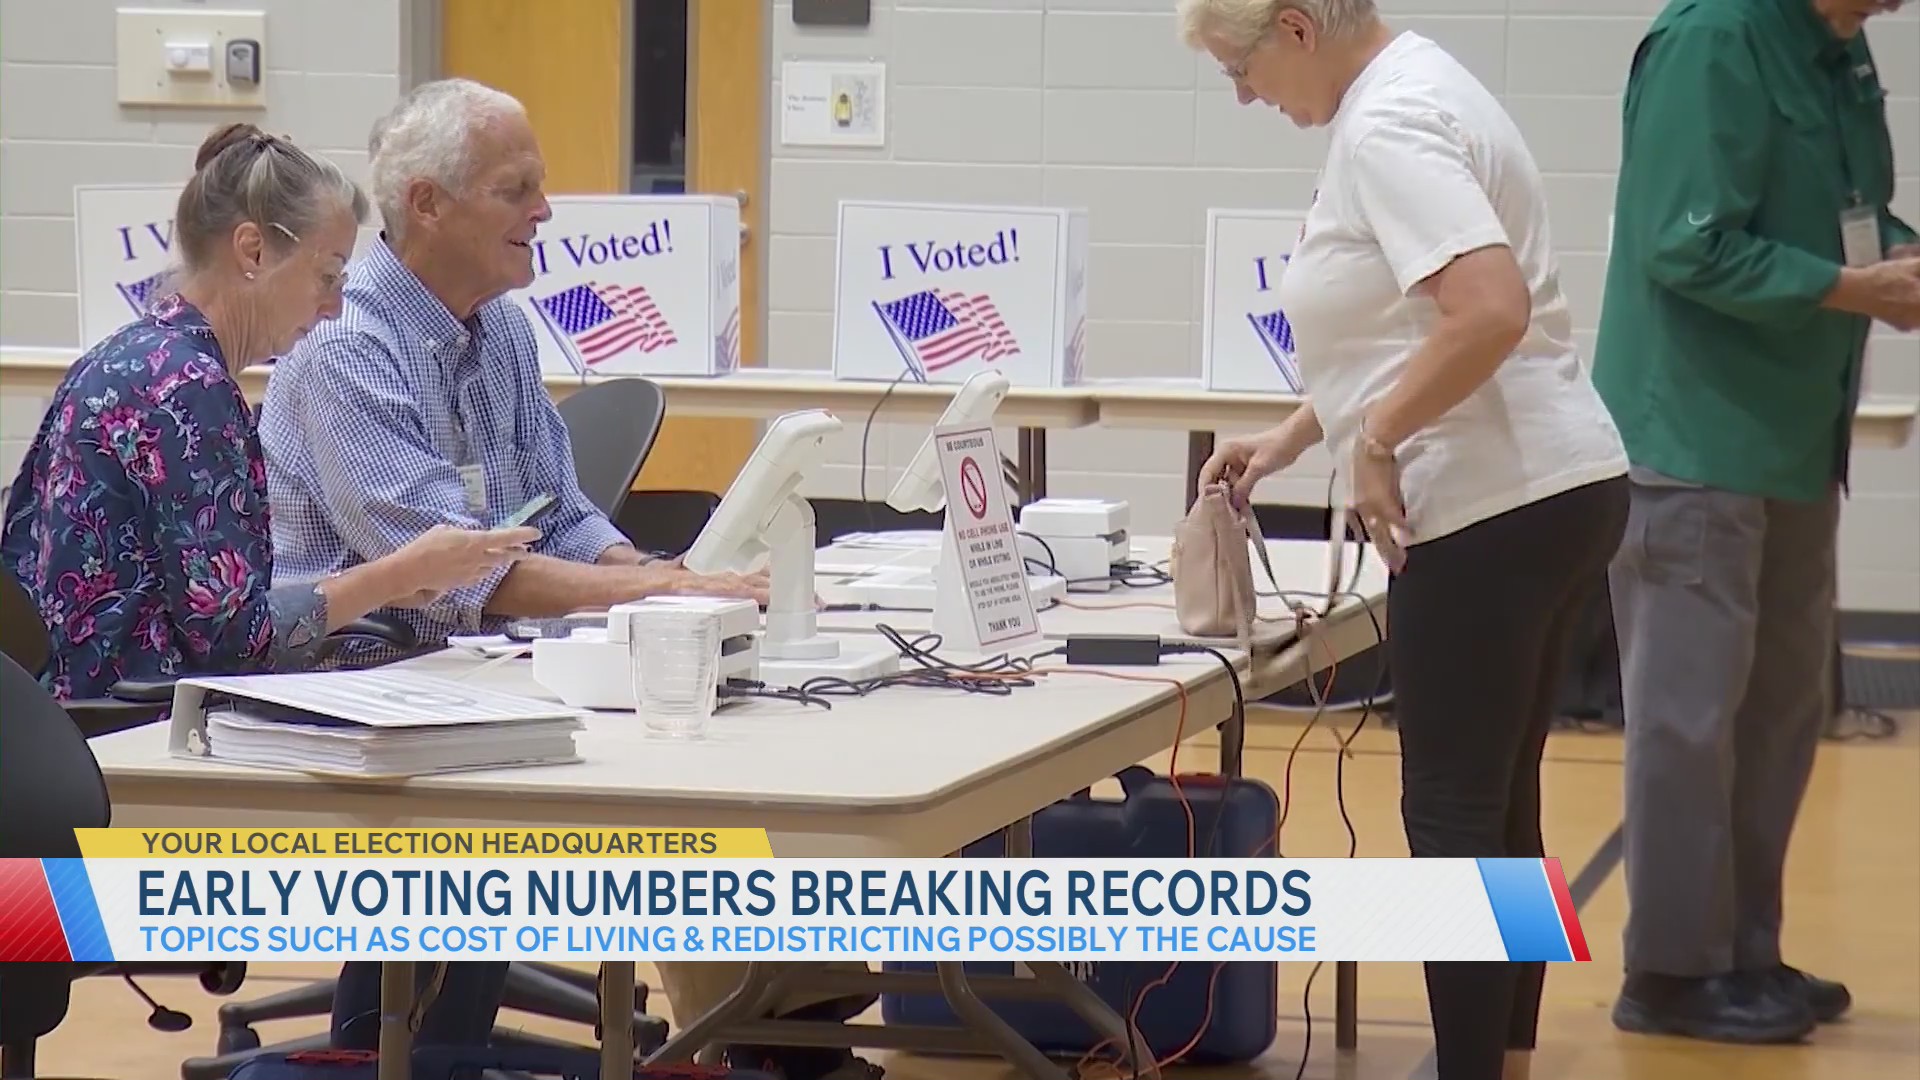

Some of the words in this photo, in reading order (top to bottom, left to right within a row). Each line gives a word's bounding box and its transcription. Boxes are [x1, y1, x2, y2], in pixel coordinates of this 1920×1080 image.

[117, 226, 137, 261] I
[534, 239, 550, 276] I
[560, 218, 674, 268] Voted!
[877, 243, 896, 281] I
[905, 228, 1021, 273] Voted!
[1253, 256, 1272, 292] I
[967, 527, 980, 539] CELL
[988, 618, 1007, 632] THANK
[1007, 615, 1020, 628] YOU
